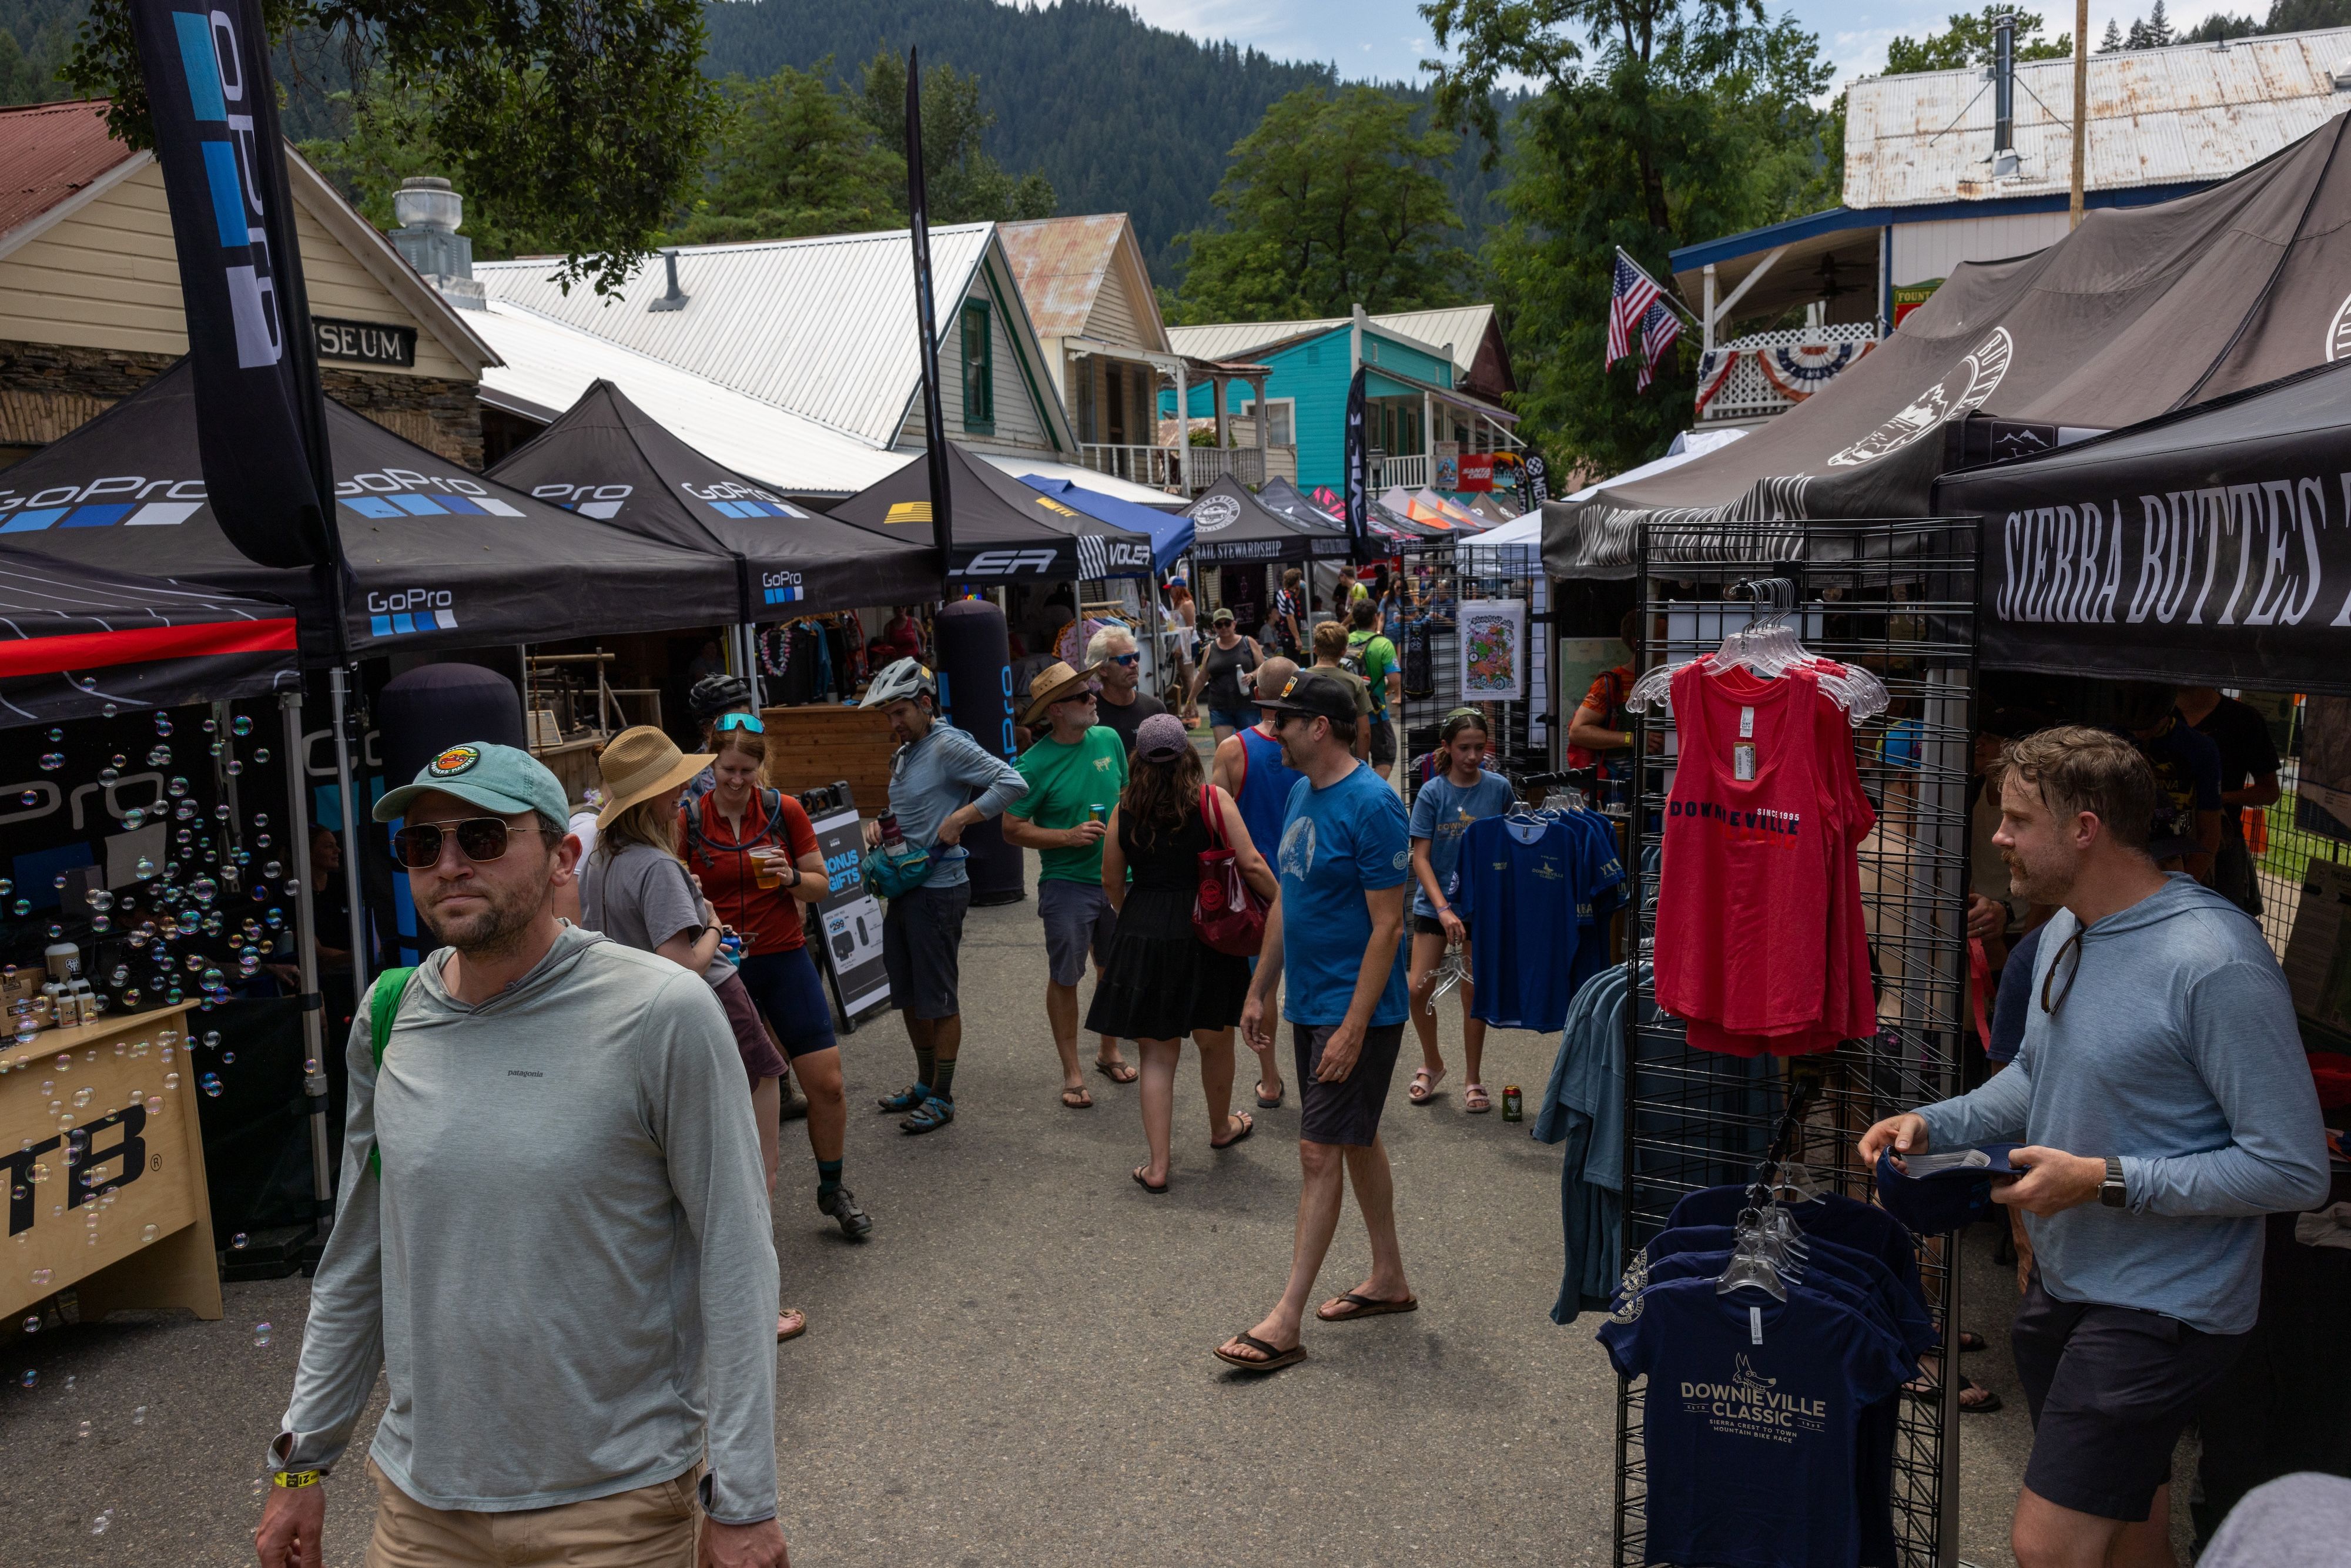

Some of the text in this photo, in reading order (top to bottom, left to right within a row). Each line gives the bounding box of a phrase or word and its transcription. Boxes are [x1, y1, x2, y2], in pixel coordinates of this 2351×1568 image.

[1898, 290, 1935, 302] FOUNT
[313, 323, 402, 361] SEUM
[681, 481, 781, 503] GoPro
[1109, 543, 1150, 567] VOLER
[1217, 540, 1282, 559] STEWARDSHIP
[1997, 499, 2122, 624] SIERRA
[2125, 475, 2326, 626] BUTTES
[762, 571, 802, 587] GoPro
[367, 588, 453, 612] GoPro
[451, 757, 475, 773] MARKET
[1670, 801, 1800, 835] DOWNIEVILLE
[1757, 808, 1800, 822] SINCE 1995
[829, 866, 860, 892] GIFTS
[507, 1070, 544, 1078] patagonia
[1680, 1382, 1826, 1418] DOWNIEVILLE
[1712, 1401, 1793, 1428] CLASSIC
[1801, 1420, 1821, 1429] 1995
[1709, 1419, 1734, 1427] SIERRA
[1737, 1422, 1760, 1431] CREST
[1776, 1429, 1797, 1438] TOWN
[1713, 1426, 1751, 1436] MOUNTAIN
[1773, 1435, 1793, 1443] RACE
